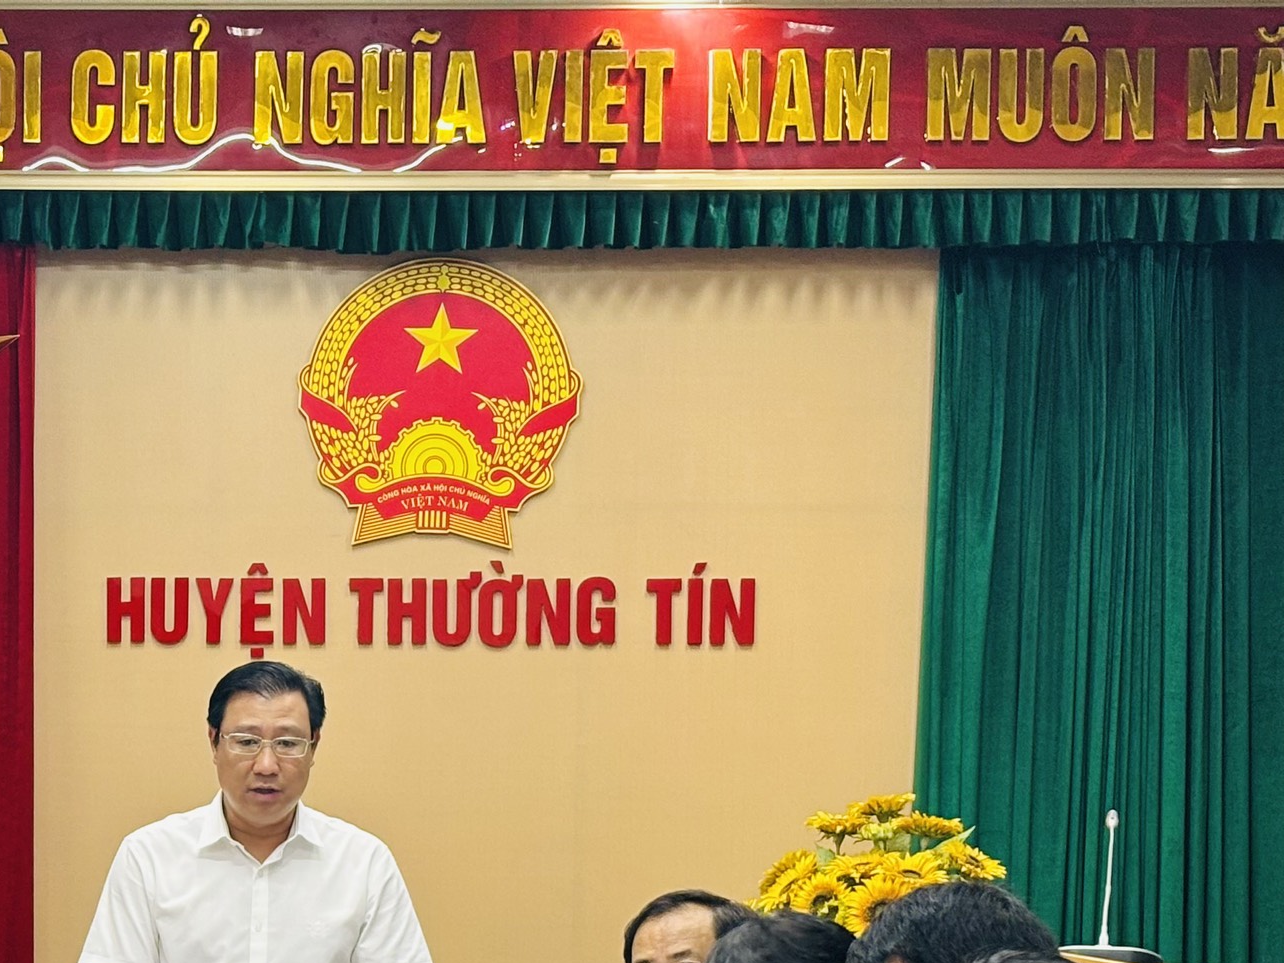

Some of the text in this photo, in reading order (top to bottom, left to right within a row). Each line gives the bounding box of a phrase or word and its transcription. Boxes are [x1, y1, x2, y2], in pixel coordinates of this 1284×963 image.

[71, 14, 219, 146] CHỦ
[253, 28, 487, 147] NGHĨA
[513, 28, 675, 164] VIỆT
[707, 47, 891, 144] NAM
[925, 25, 1156, 143] MUÔN
[377, 482, 491, 506] CỘNG HÒA XÃ HỘI CHỦ NGHĨA
[400, 493, 469, 512] VIỆT NAM
[105, 560, 757, 659] HUYỆN THƯỜNG TÍN
